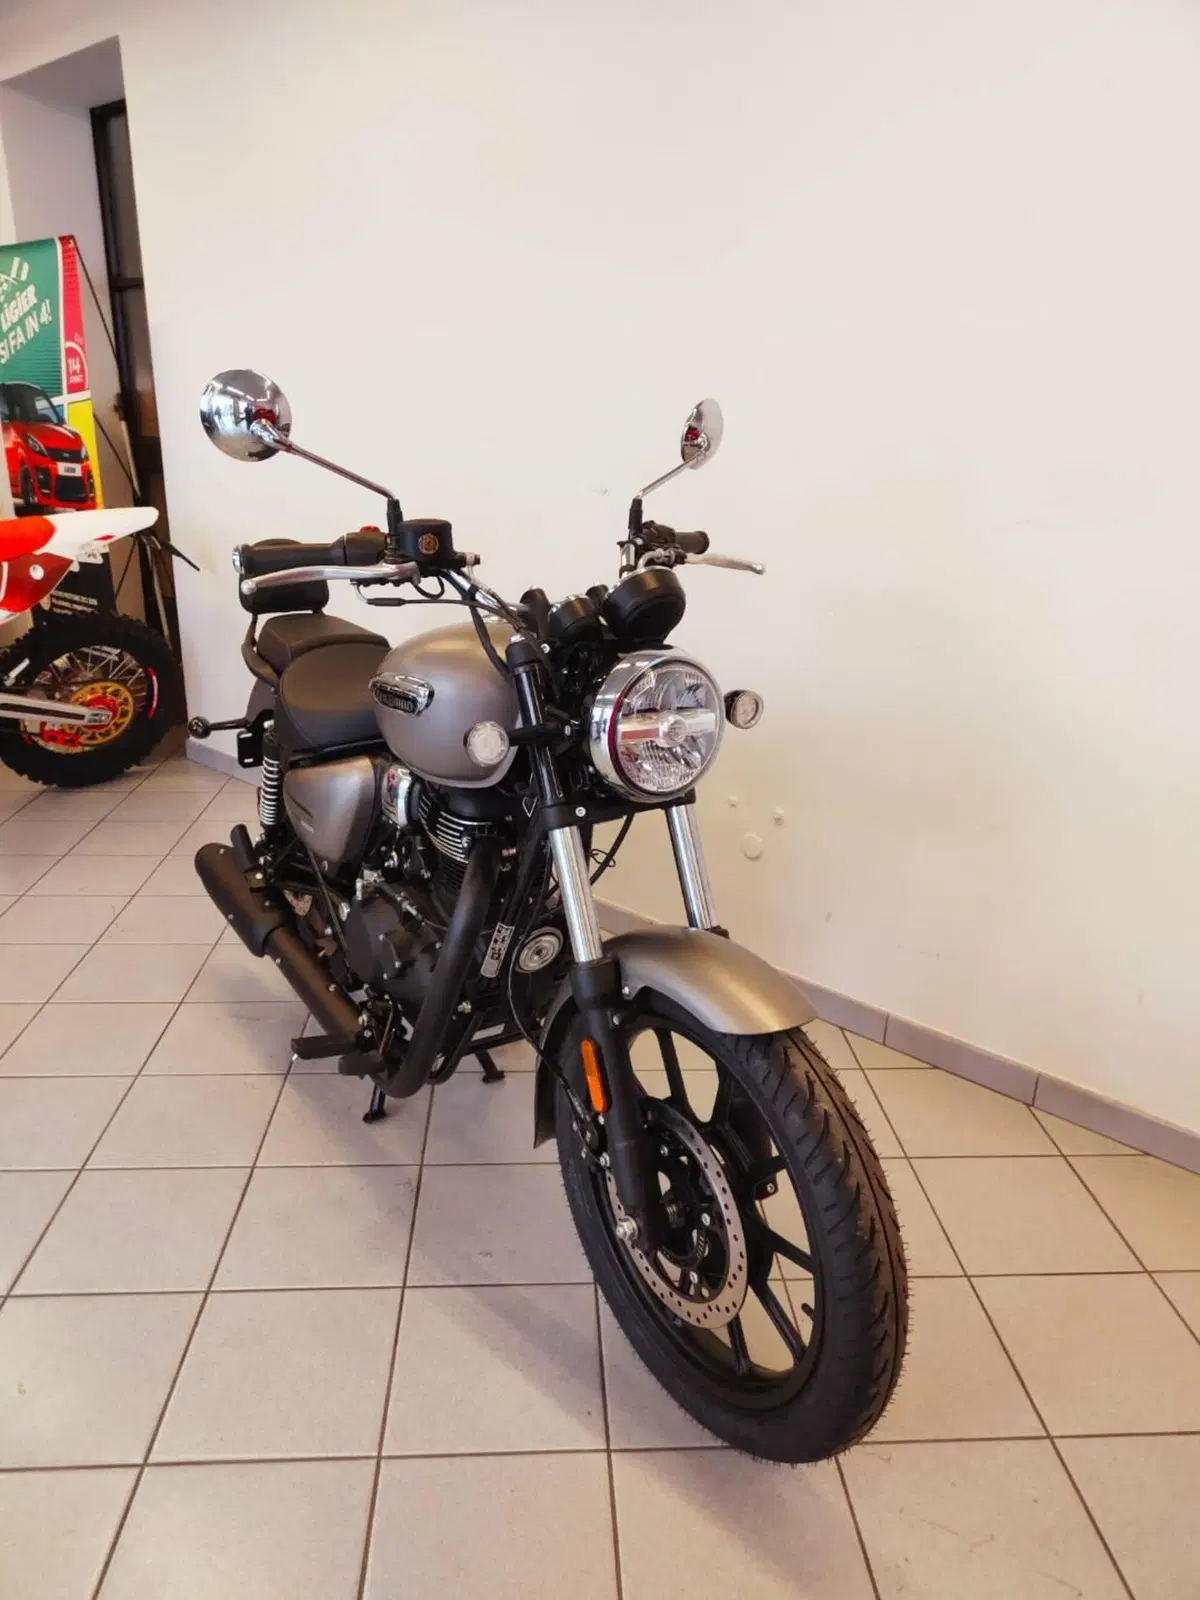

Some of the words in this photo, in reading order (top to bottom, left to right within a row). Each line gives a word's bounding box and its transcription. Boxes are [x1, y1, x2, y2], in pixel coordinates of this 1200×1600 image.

[9, 326, 26, 355] FA
[25, 311, 39, 340] IN
[40, 298, 52, 325] 4!
